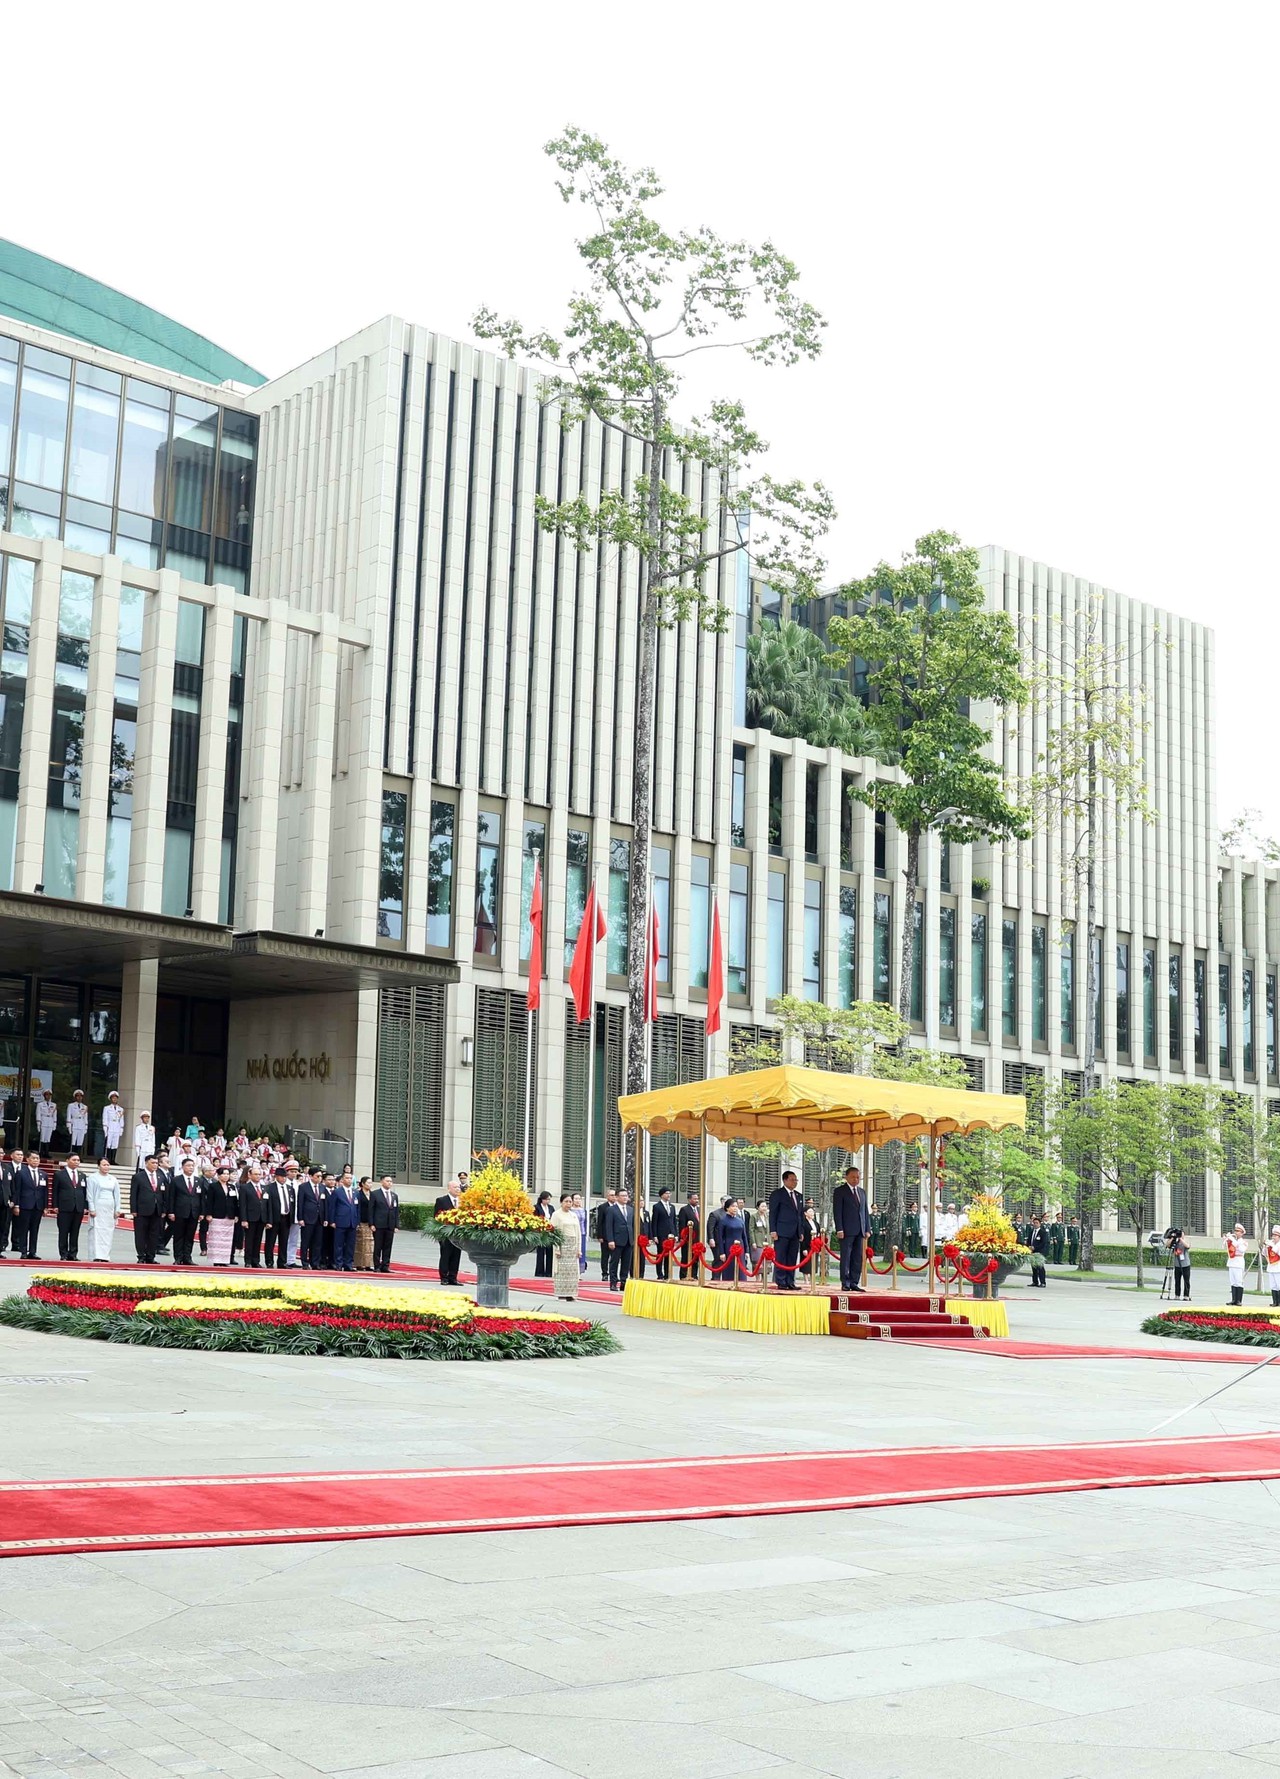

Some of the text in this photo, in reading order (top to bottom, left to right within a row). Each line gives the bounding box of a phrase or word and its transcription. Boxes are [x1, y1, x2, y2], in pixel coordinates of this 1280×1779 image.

[247, 1049, 330, 1083] NHÀ QUỐC HỘI
